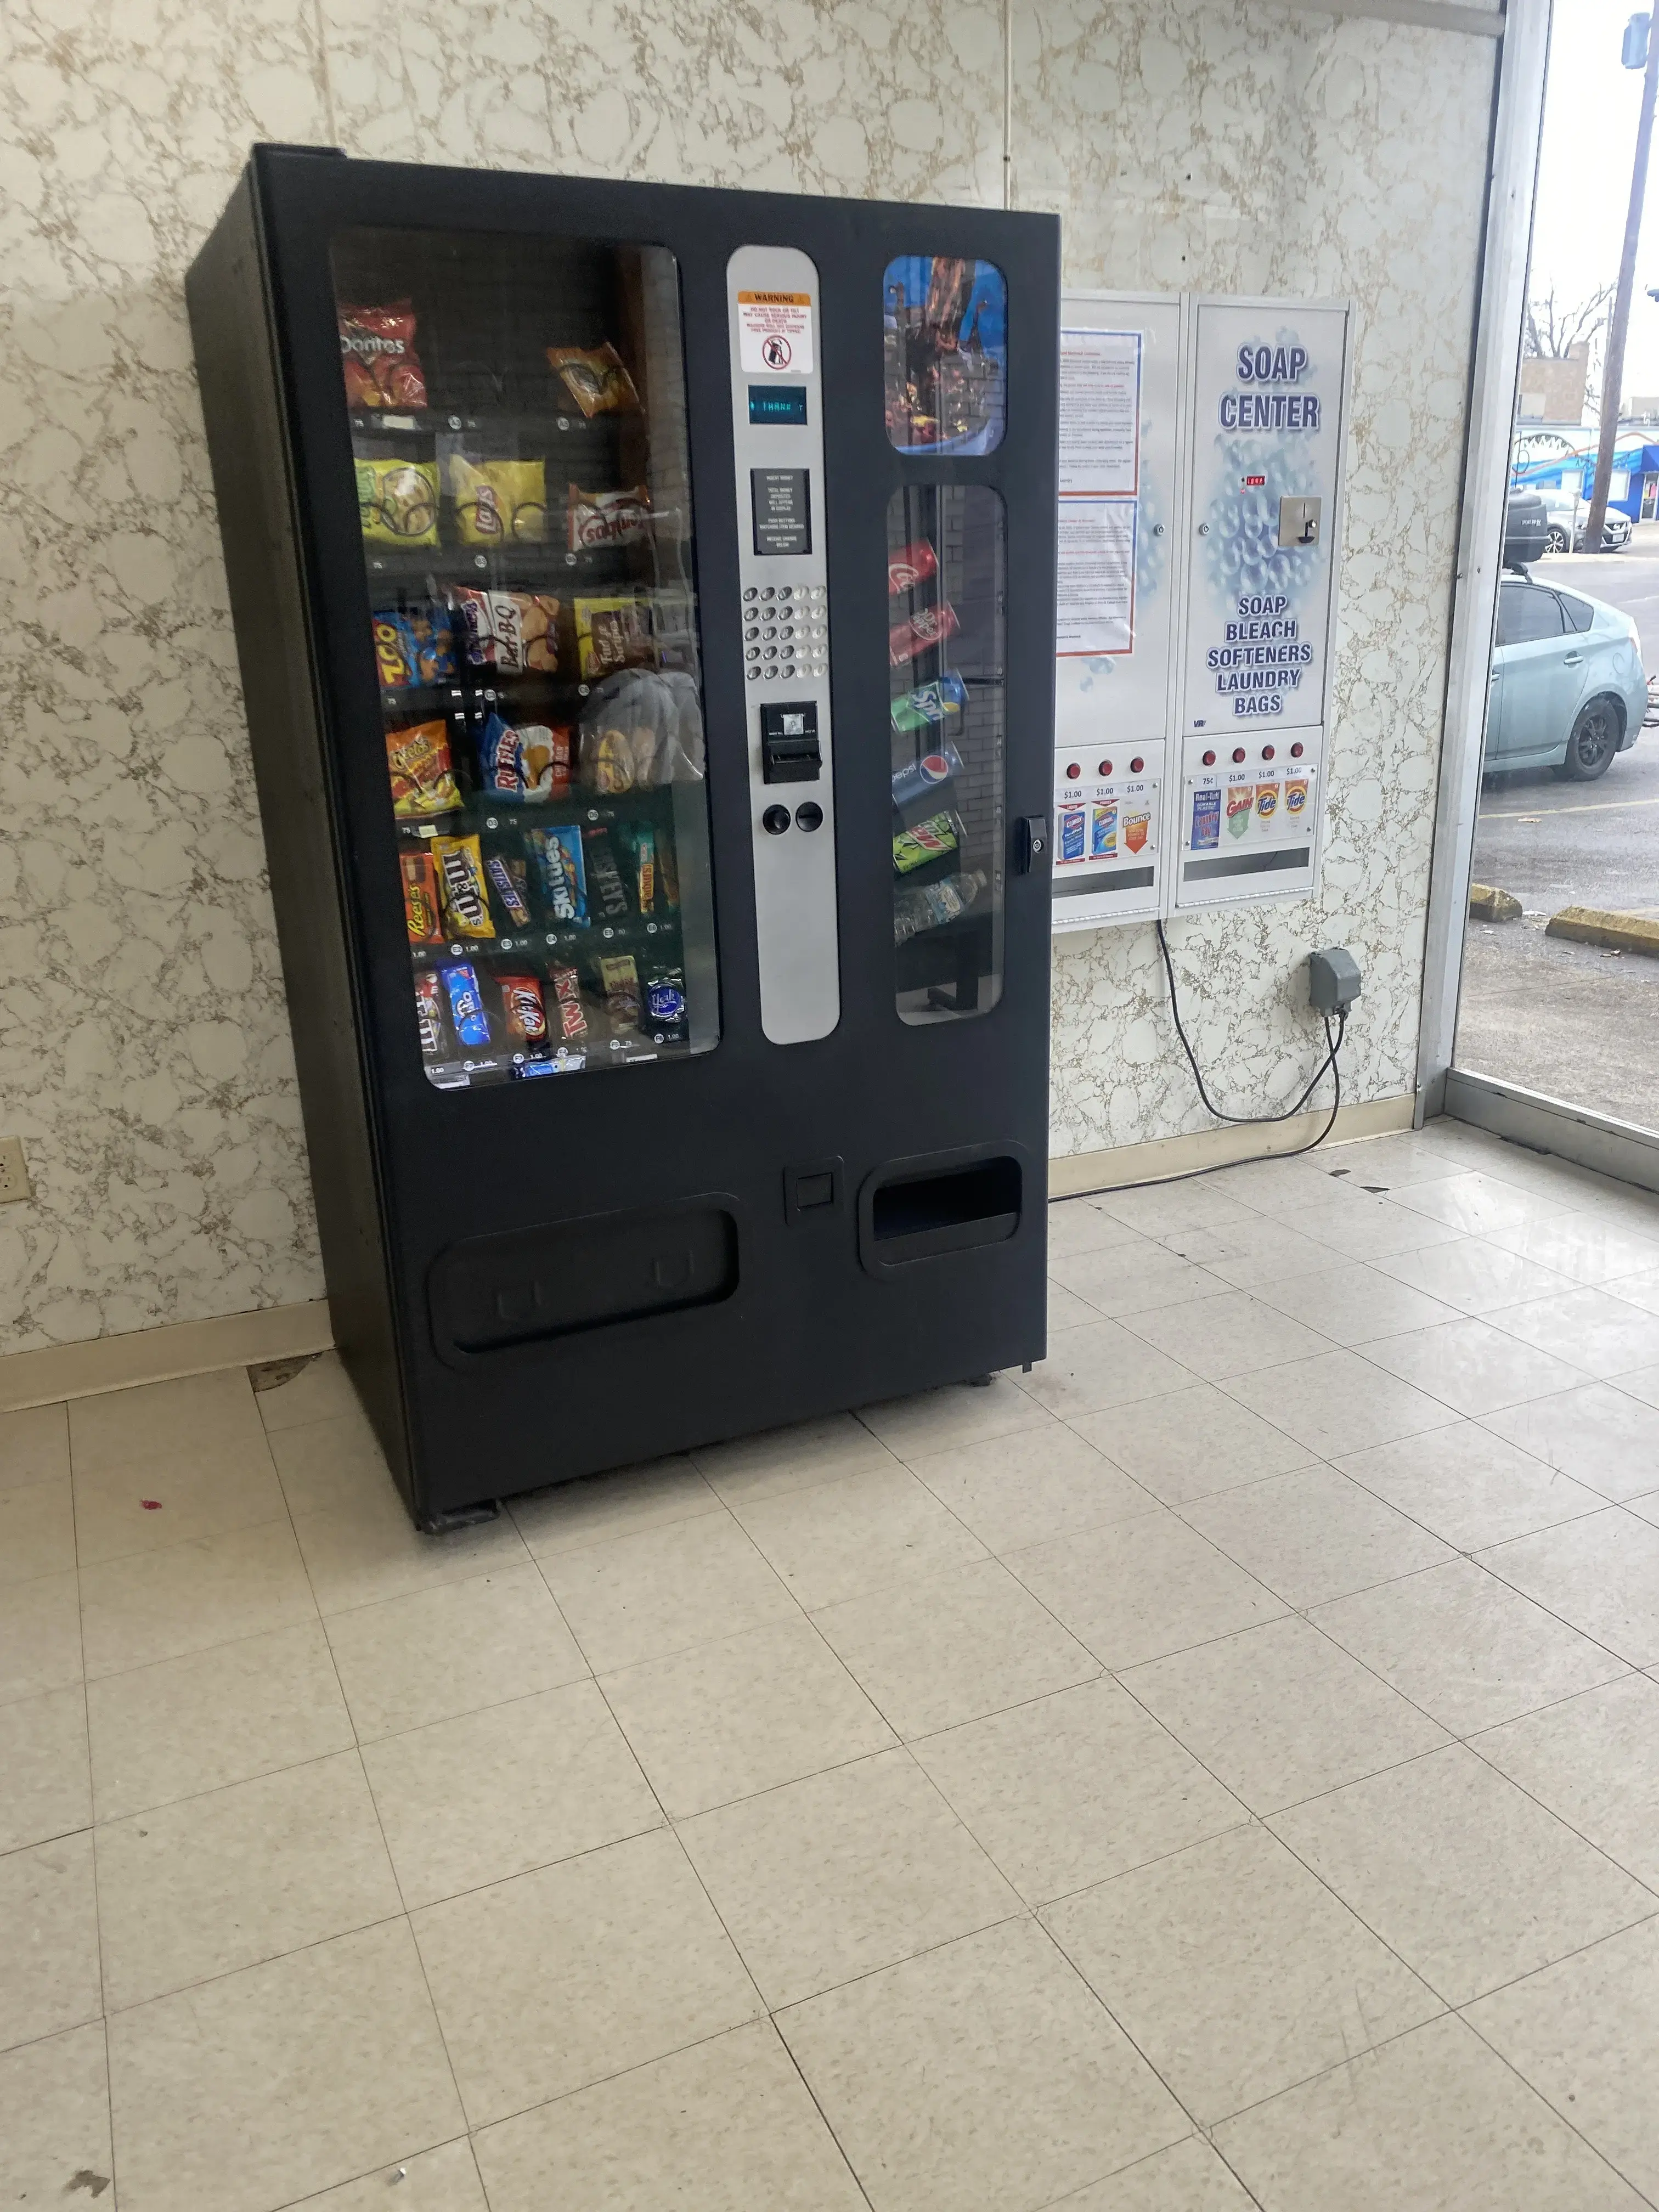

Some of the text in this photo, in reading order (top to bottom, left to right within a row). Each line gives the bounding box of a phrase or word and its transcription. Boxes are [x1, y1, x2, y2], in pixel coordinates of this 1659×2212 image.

[754, 293, 794, 303] WARNING
[1238, 347, 1307, 380] SOAP
[1220, 394, 1318, 428] CENTER
[1238, 596, 1286, 615] SOAP
[1226, 620, 1295, 640] BLEACH
[1208, 644, 1311, 667] SOFTENERS
[1217, 669, 1300, 691] LAUNDRY
[1235, 695, 1280, 714] BAGS
[1259, 770, 1274, 778] $1.00
[1064, 791, 1082, 799] $1.00
[1097, 787, 1114, 795] $1.00
[1127, 785, 1144, 793] $1.00
[1257, 796, 1277, 814] Tide
[1286, 792, 1305, 810] Tide
[1066, 816, 1082, 828] CLOROX
[1098, 817, 1112, 826] CLOROX
[1124, 812, 1150, 827] Bounce
[407, 884, 426, 936] Reese's
